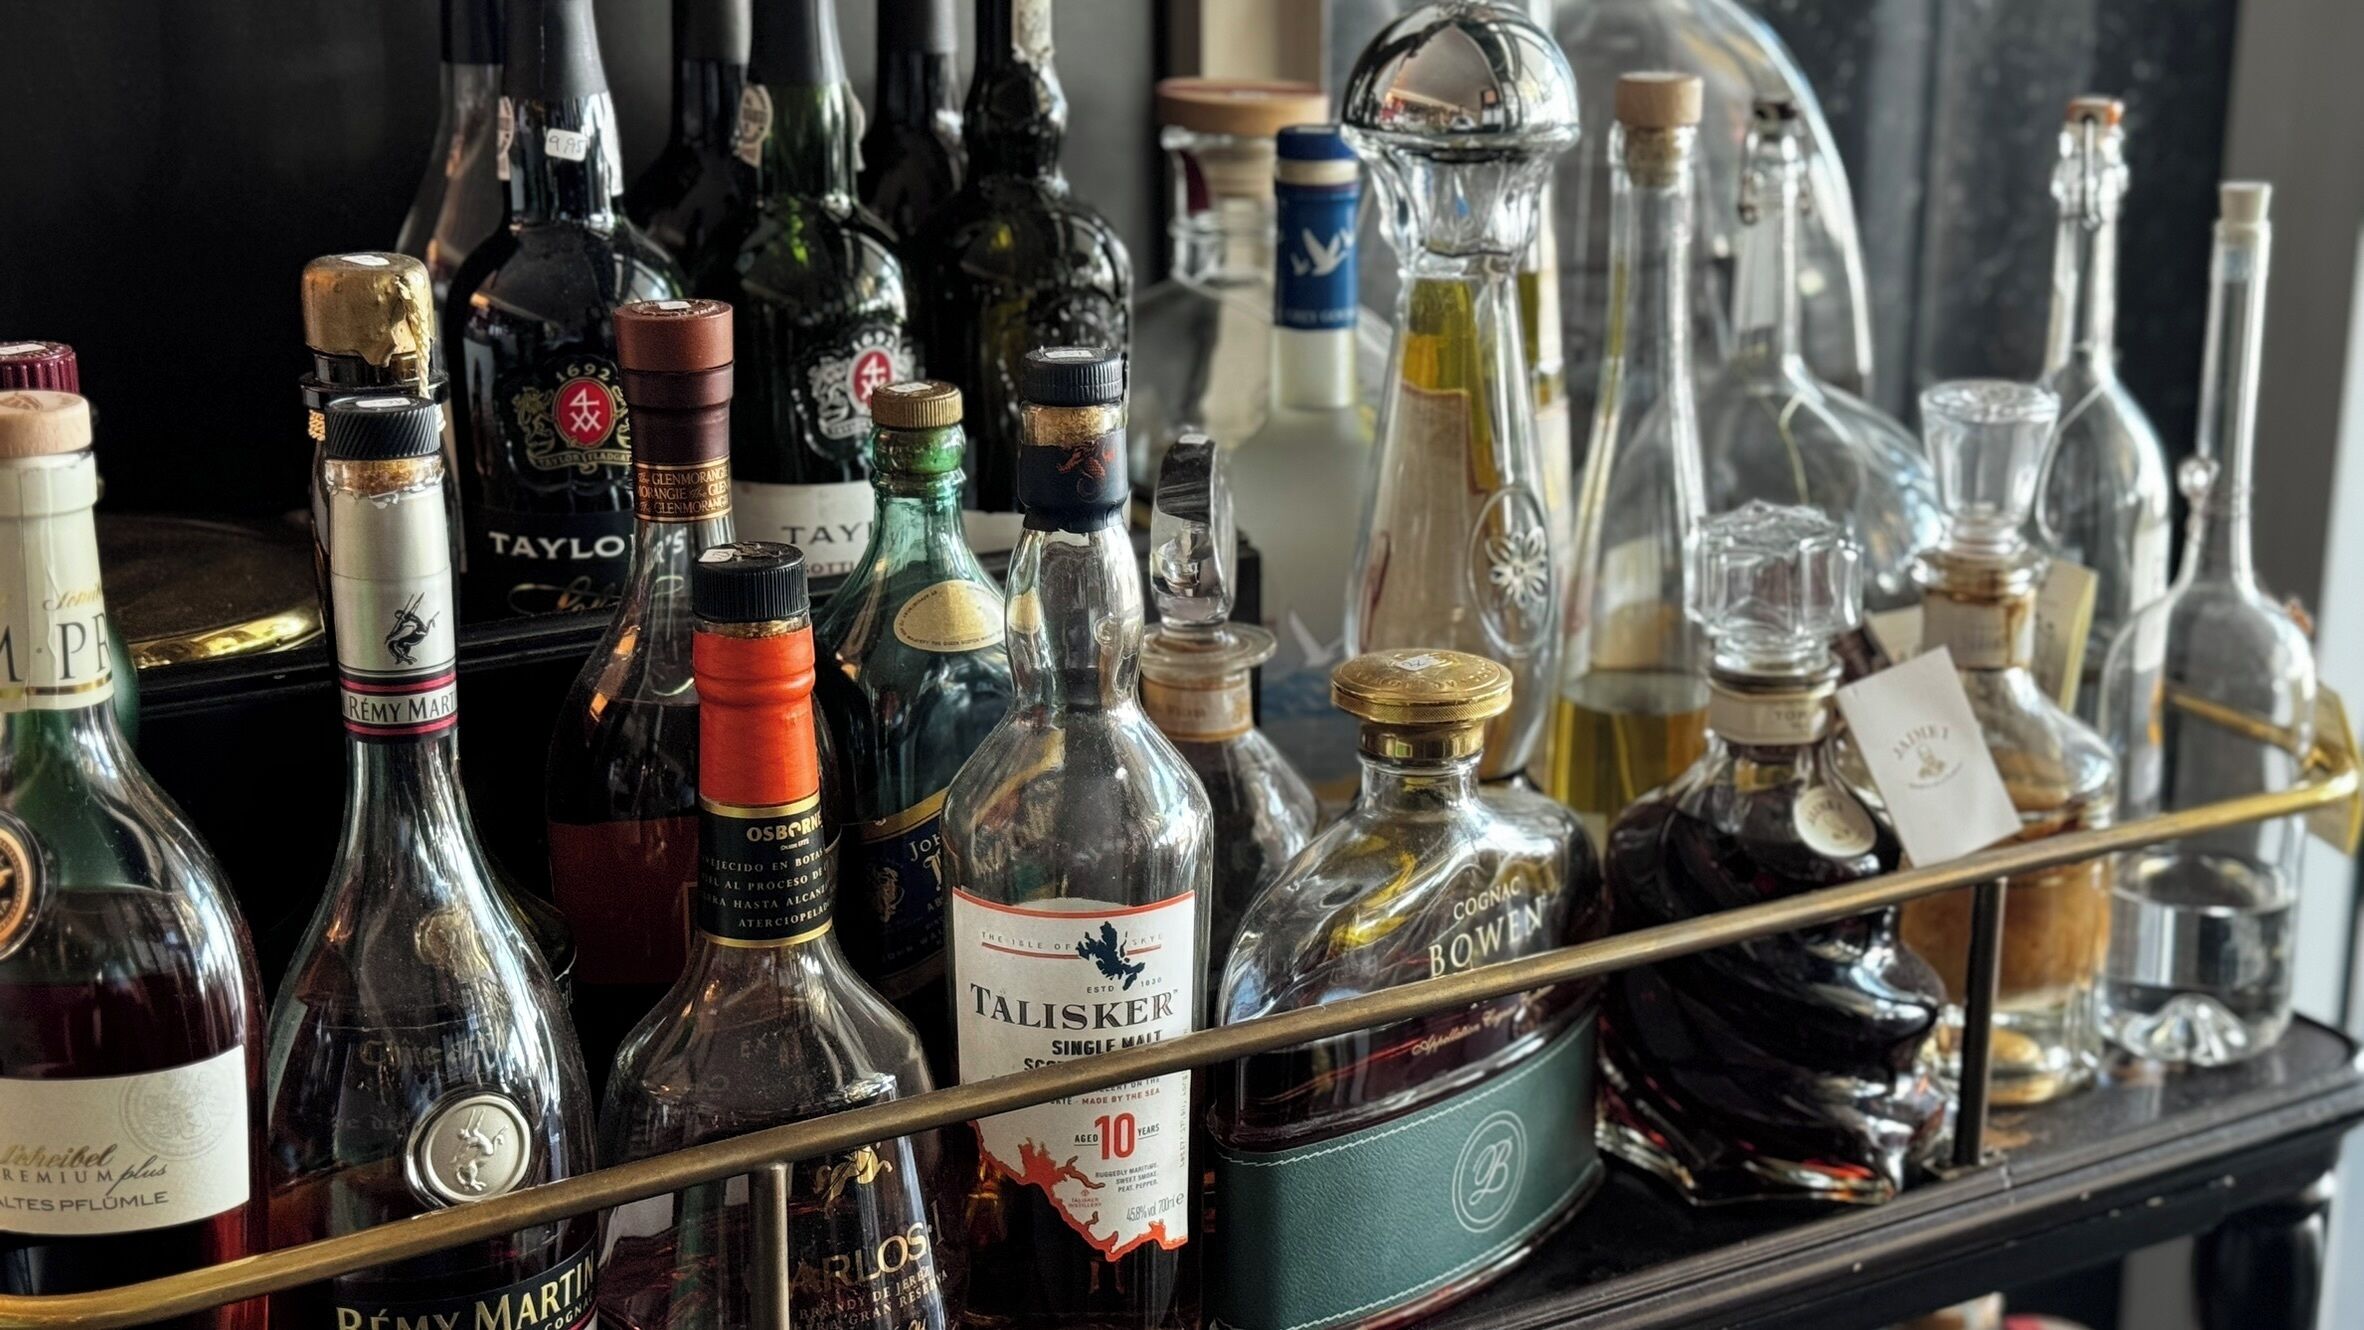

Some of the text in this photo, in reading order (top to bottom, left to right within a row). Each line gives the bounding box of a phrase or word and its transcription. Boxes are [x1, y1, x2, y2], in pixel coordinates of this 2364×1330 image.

[556, 363, 611, 383] 1692
[588, 452, 632, 462] FLADGAT
[708, 481, 729, 496] GLEN
[488, 530, 635, 560] TAYLO
[348, 691, 456, 722] RÉMY MART
[746, 811, 823, 843] OSBORNE
[772, 861, 788, 871] EN
[724, 881, 741, 890] AL
[748, 875, 808, 891] PROCESO
[734, 899, 779, 910] HASTA
[1453, 876, 1521, 921] COGNAC
[982, 931, 1003, 943] THE
[1011, 938, 1044, 949] ISLE
[1054, 942, 1072, 951] OF
[1428, 895, 1547, 979] BOWEN
[1086, 986, 1115, 994] ESTD
[970, 982, 1174, 1031] TALISKER
[1052, 1038, 1115, 1056] SINGLE
[1082, 1096, 1109, 1105] MADE
[1111, 1094, 1123, 1103] BY
[1126, 1092, 1142, 1101] THE
[1145, 1087, 1161, 1097] SEA
[1074, 1112, 1160, 1160] AGED 10 YEARS
[3, 1154, 169, 1196] REMIUM plus
[60, 1191, 169, 1212] PFLÜMLE
[787, 1222, 929, 1300] ARLOS
[474, 1249, 595, 1330] MARTIN
[873, 1286, 891, 1303] DE
